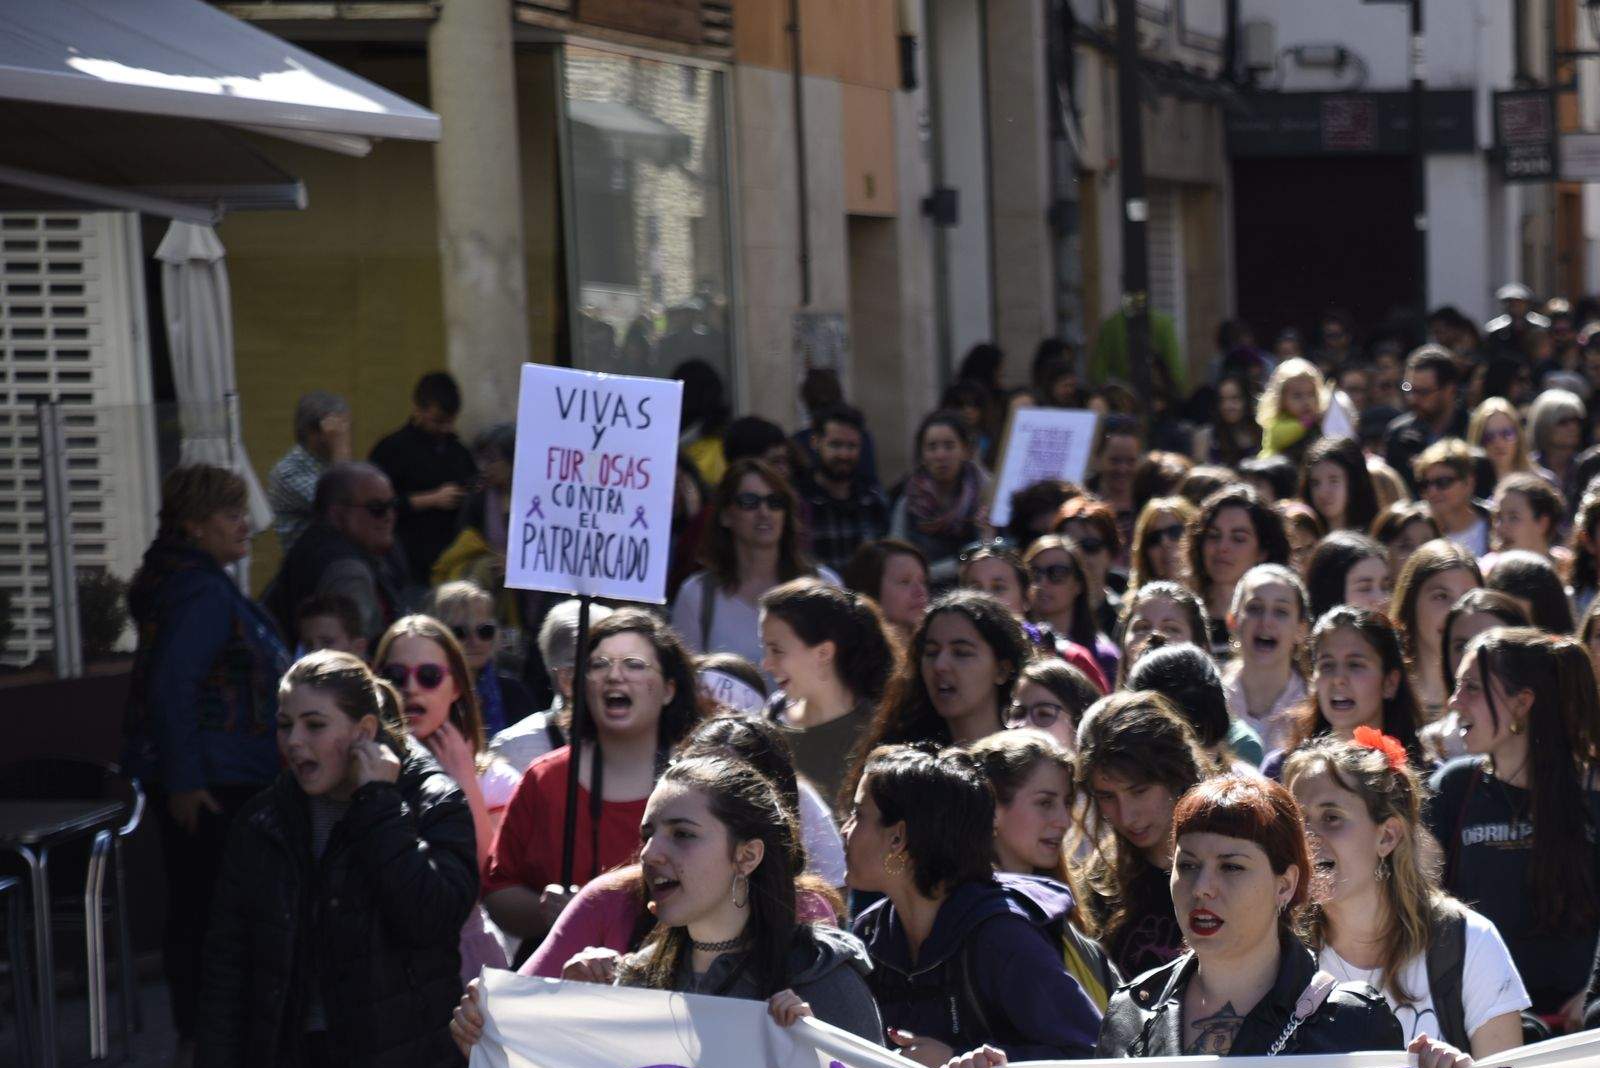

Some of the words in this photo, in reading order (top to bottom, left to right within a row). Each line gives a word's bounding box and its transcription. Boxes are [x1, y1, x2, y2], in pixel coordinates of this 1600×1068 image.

[555, 386, 651, 430] VIVAS
[592, 424, 606, 451] Y
[546, 446, 651, 490] FUROSAS
[552, 484, 624, 515] CONTRA
[579, 511, 599, 530] EL
[521, 522, 650, 583] PATRIARCADO
